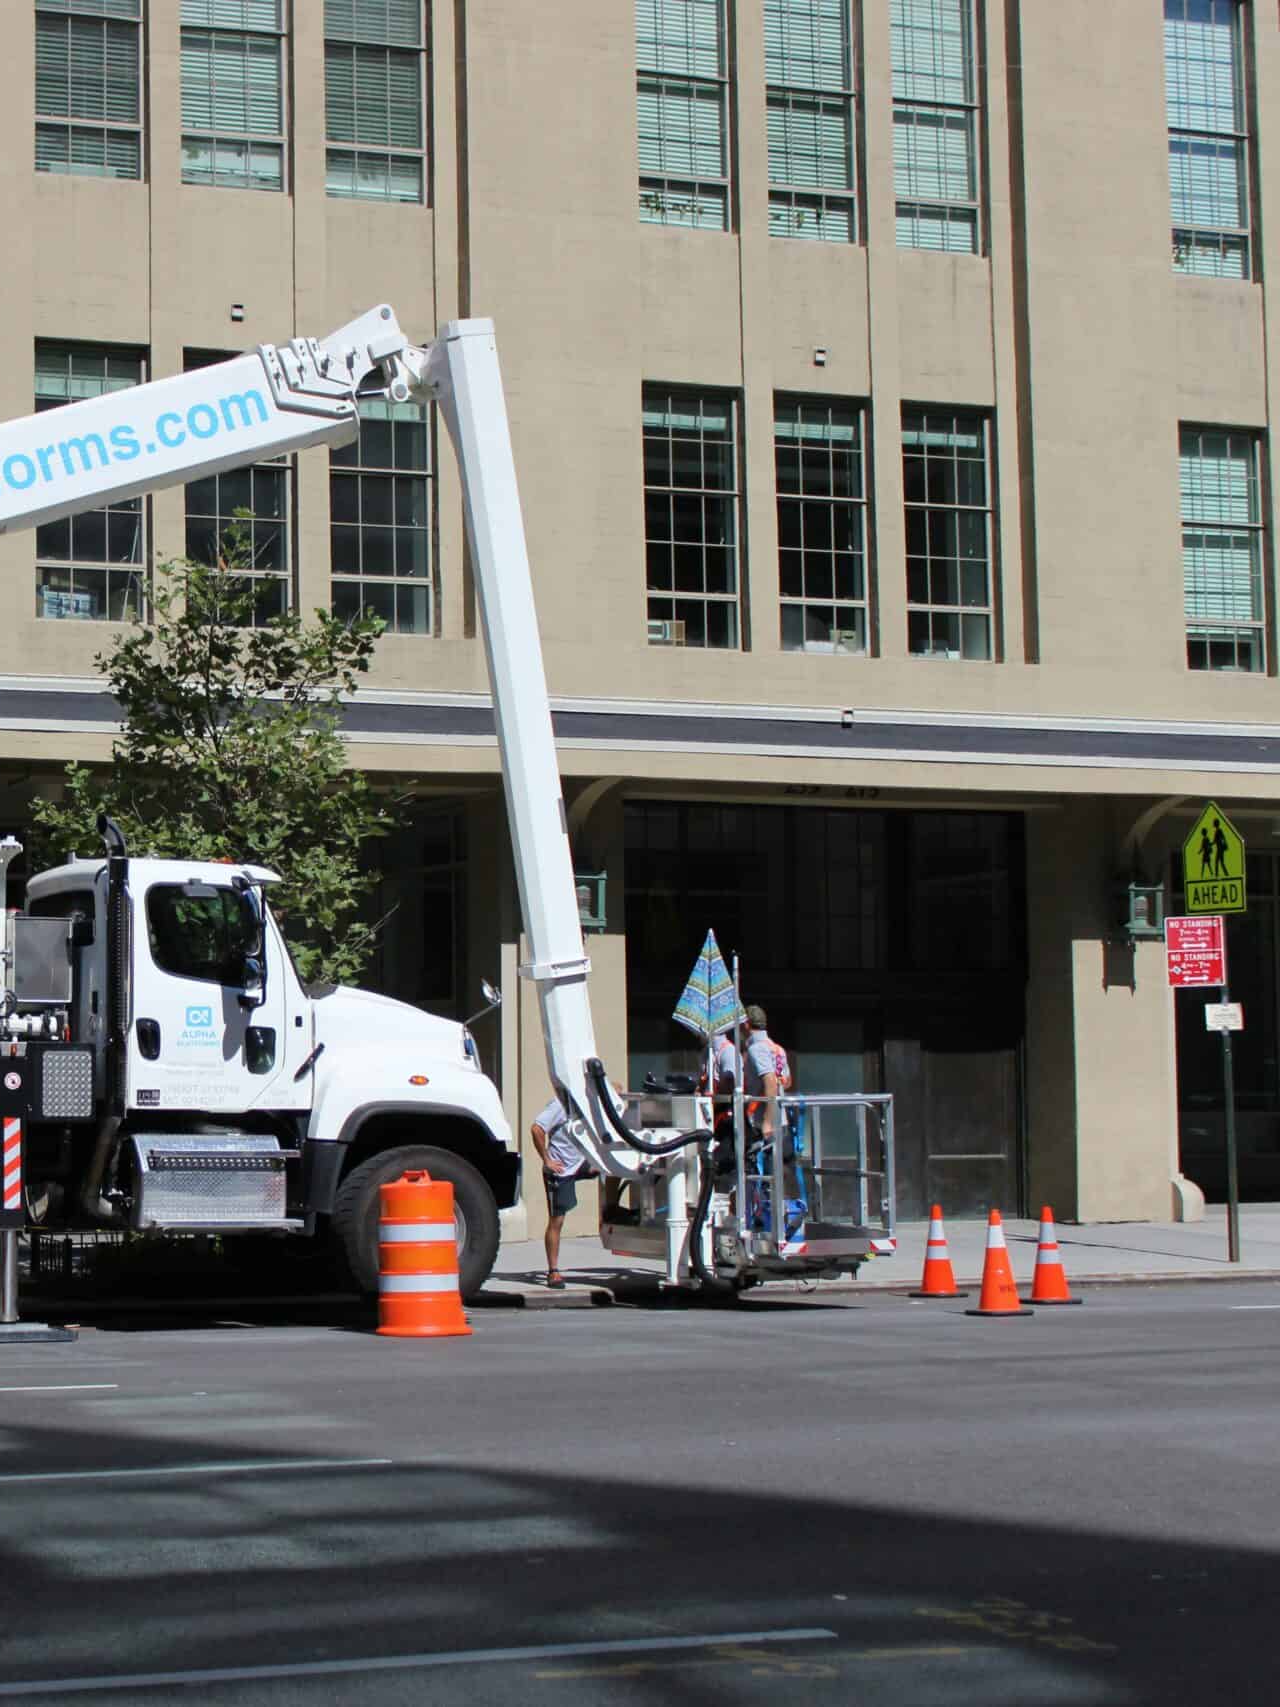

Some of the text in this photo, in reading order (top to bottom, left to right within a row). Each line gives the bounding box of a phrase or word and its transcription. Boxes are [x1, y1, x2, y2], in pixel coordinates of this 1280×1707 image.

[1192, 884, 1239, 905] AHEAD
[1168, 919, 1218, 929] NO STANDING
[1184, 952, 1220, 961] STANDING
